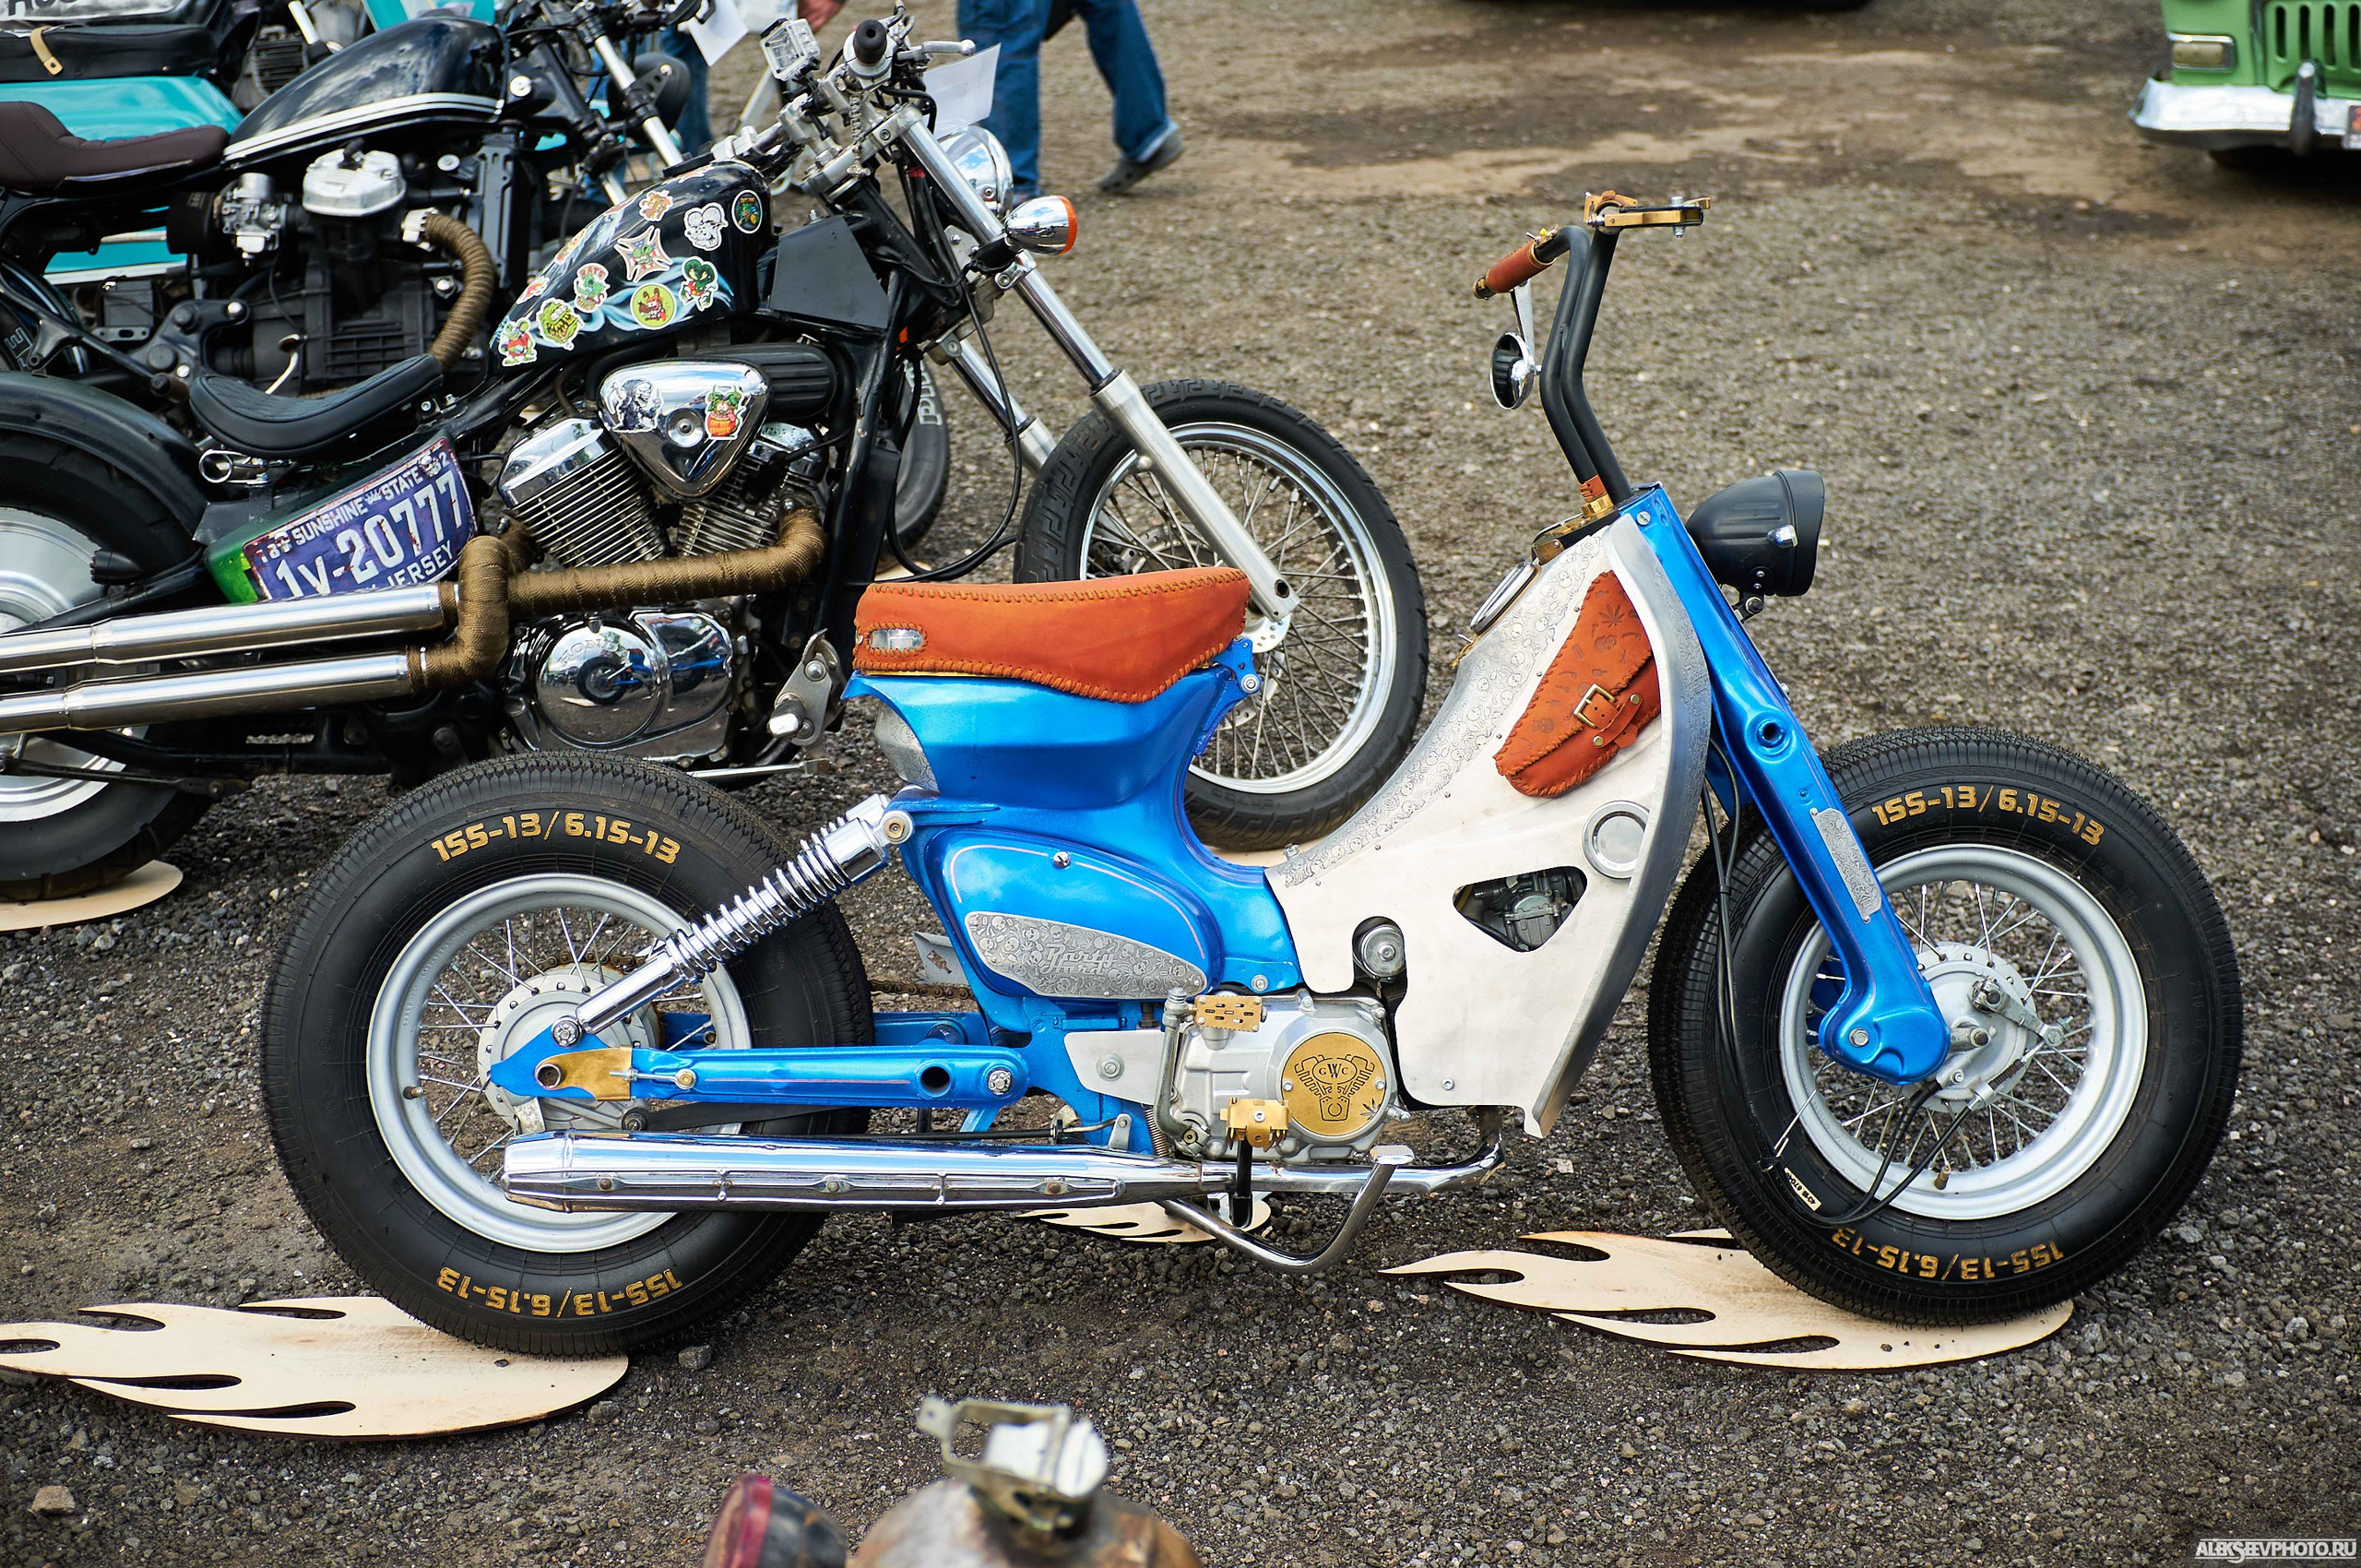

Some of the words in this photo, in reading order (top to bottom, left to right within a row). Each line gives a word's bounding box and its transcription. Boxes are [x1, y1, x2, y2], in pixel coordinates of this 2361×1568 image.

[292, 496, 369, 545] SUNSHINE
[382, 464, 424, 502] STATE
[431, 811, 682, 864] 155-13/6.15-13
[1870, 785, 2105, 846] 155-13/6.15-13
[435, 1266, 682, 1318] 155-13/6.15-13
